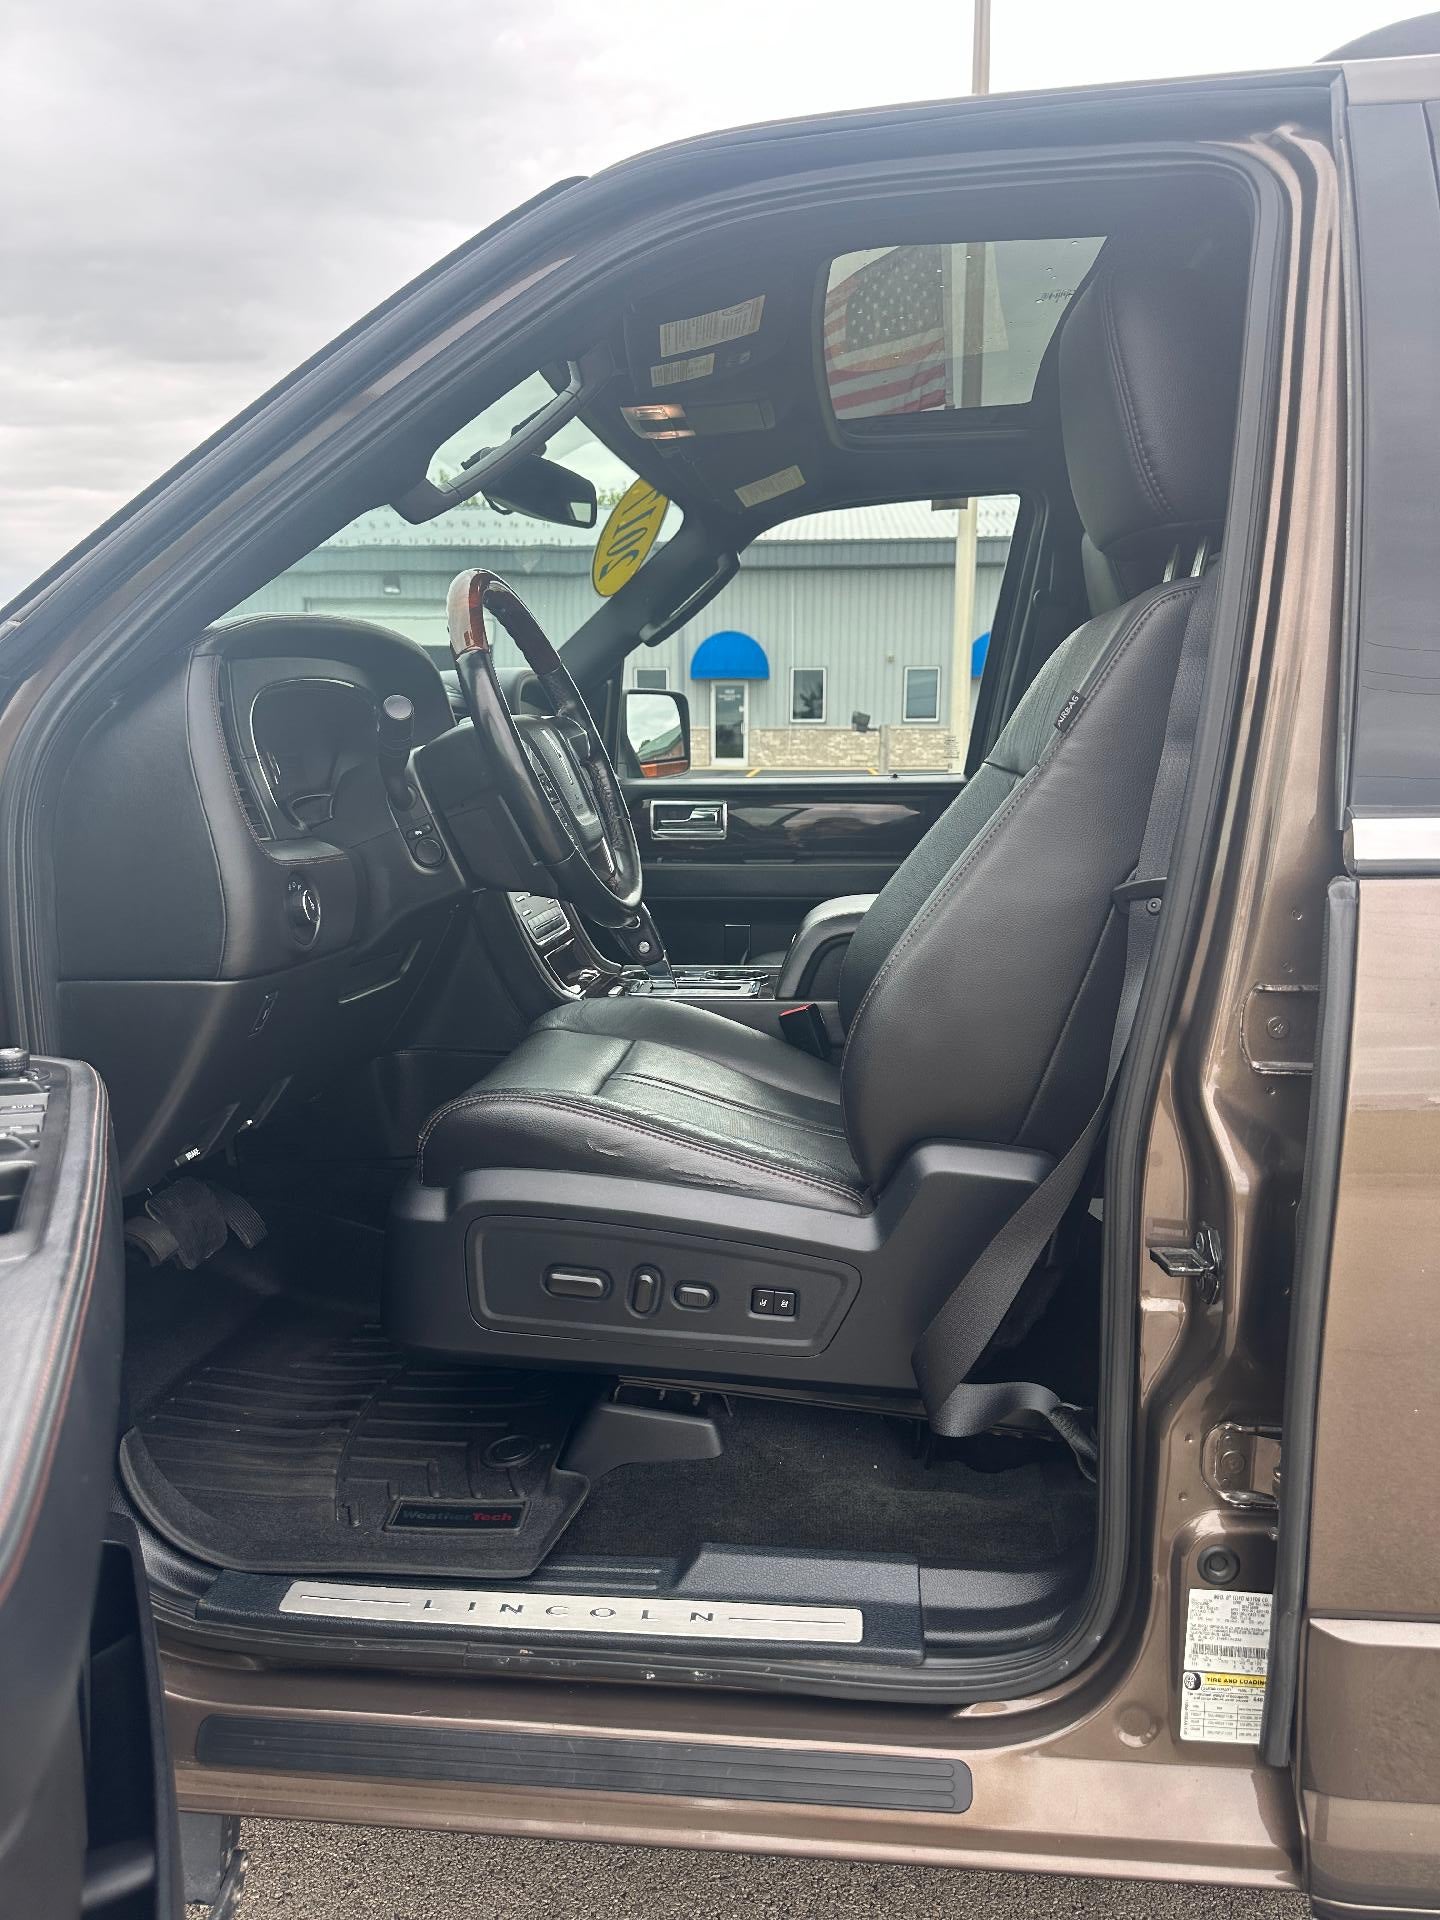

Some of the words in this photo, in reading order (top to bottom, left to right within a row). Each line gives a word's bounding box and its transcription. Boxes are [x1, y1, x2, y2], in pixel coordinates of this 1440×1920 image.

[1057, 694, 1079, 728] AIRBAG
[402, 1509, 512, 1523] WeatherTech
[424, 1599, 716, 1623] LINCOLN
